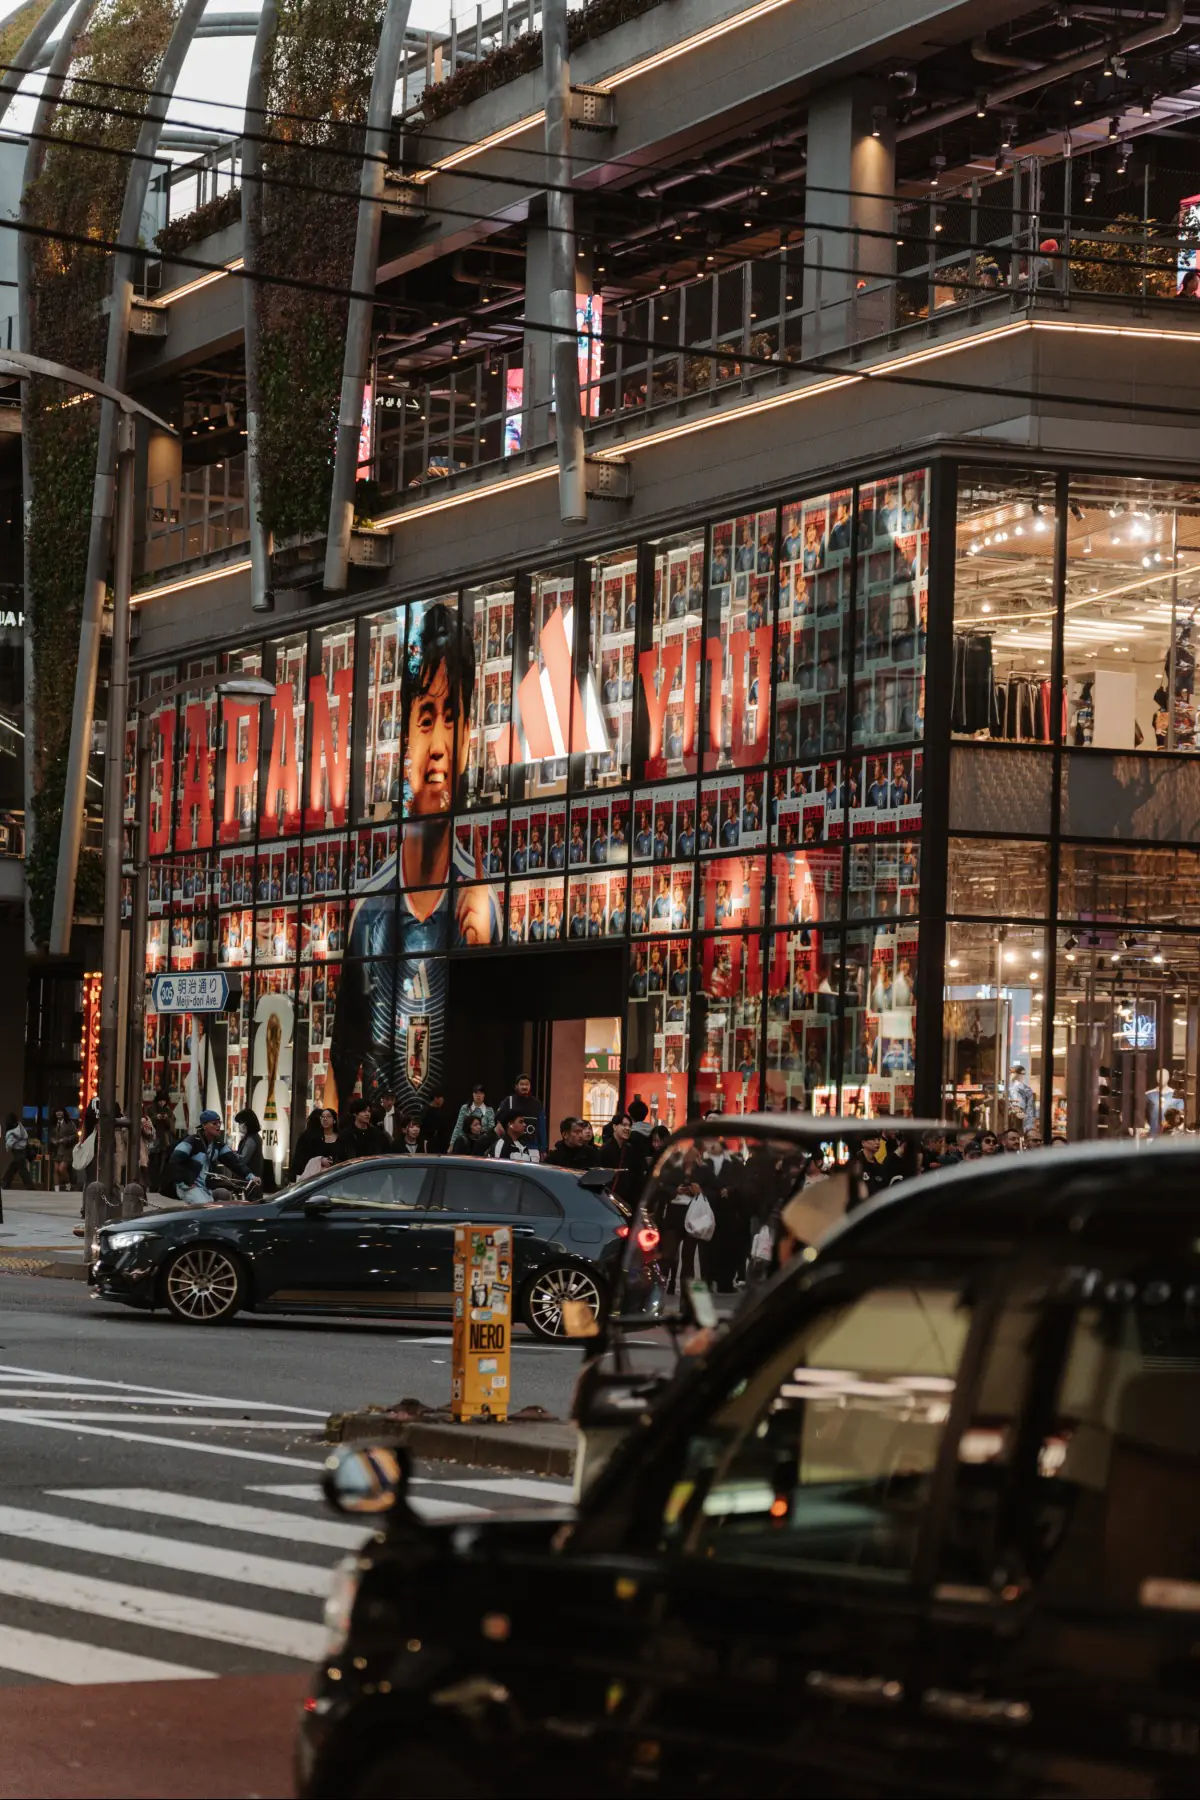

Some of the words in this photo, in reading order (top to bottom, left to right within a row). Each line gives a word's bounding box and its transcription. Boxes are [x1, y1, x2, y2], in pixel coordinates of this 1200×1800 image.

[638, 625, 773, 781] YOU
[147, 668, 353, 856] JAPAN
[161, 986, 173, 1000] 305
[178, 978, 217, 995] 明治通り
[176, 994, 204, 1008] Meiji-dori
[205, 994, 218, 1006] Ave.
[262, 1129, 278, 1146] FIFA
[470, 1323, 505, 1349] NERO
